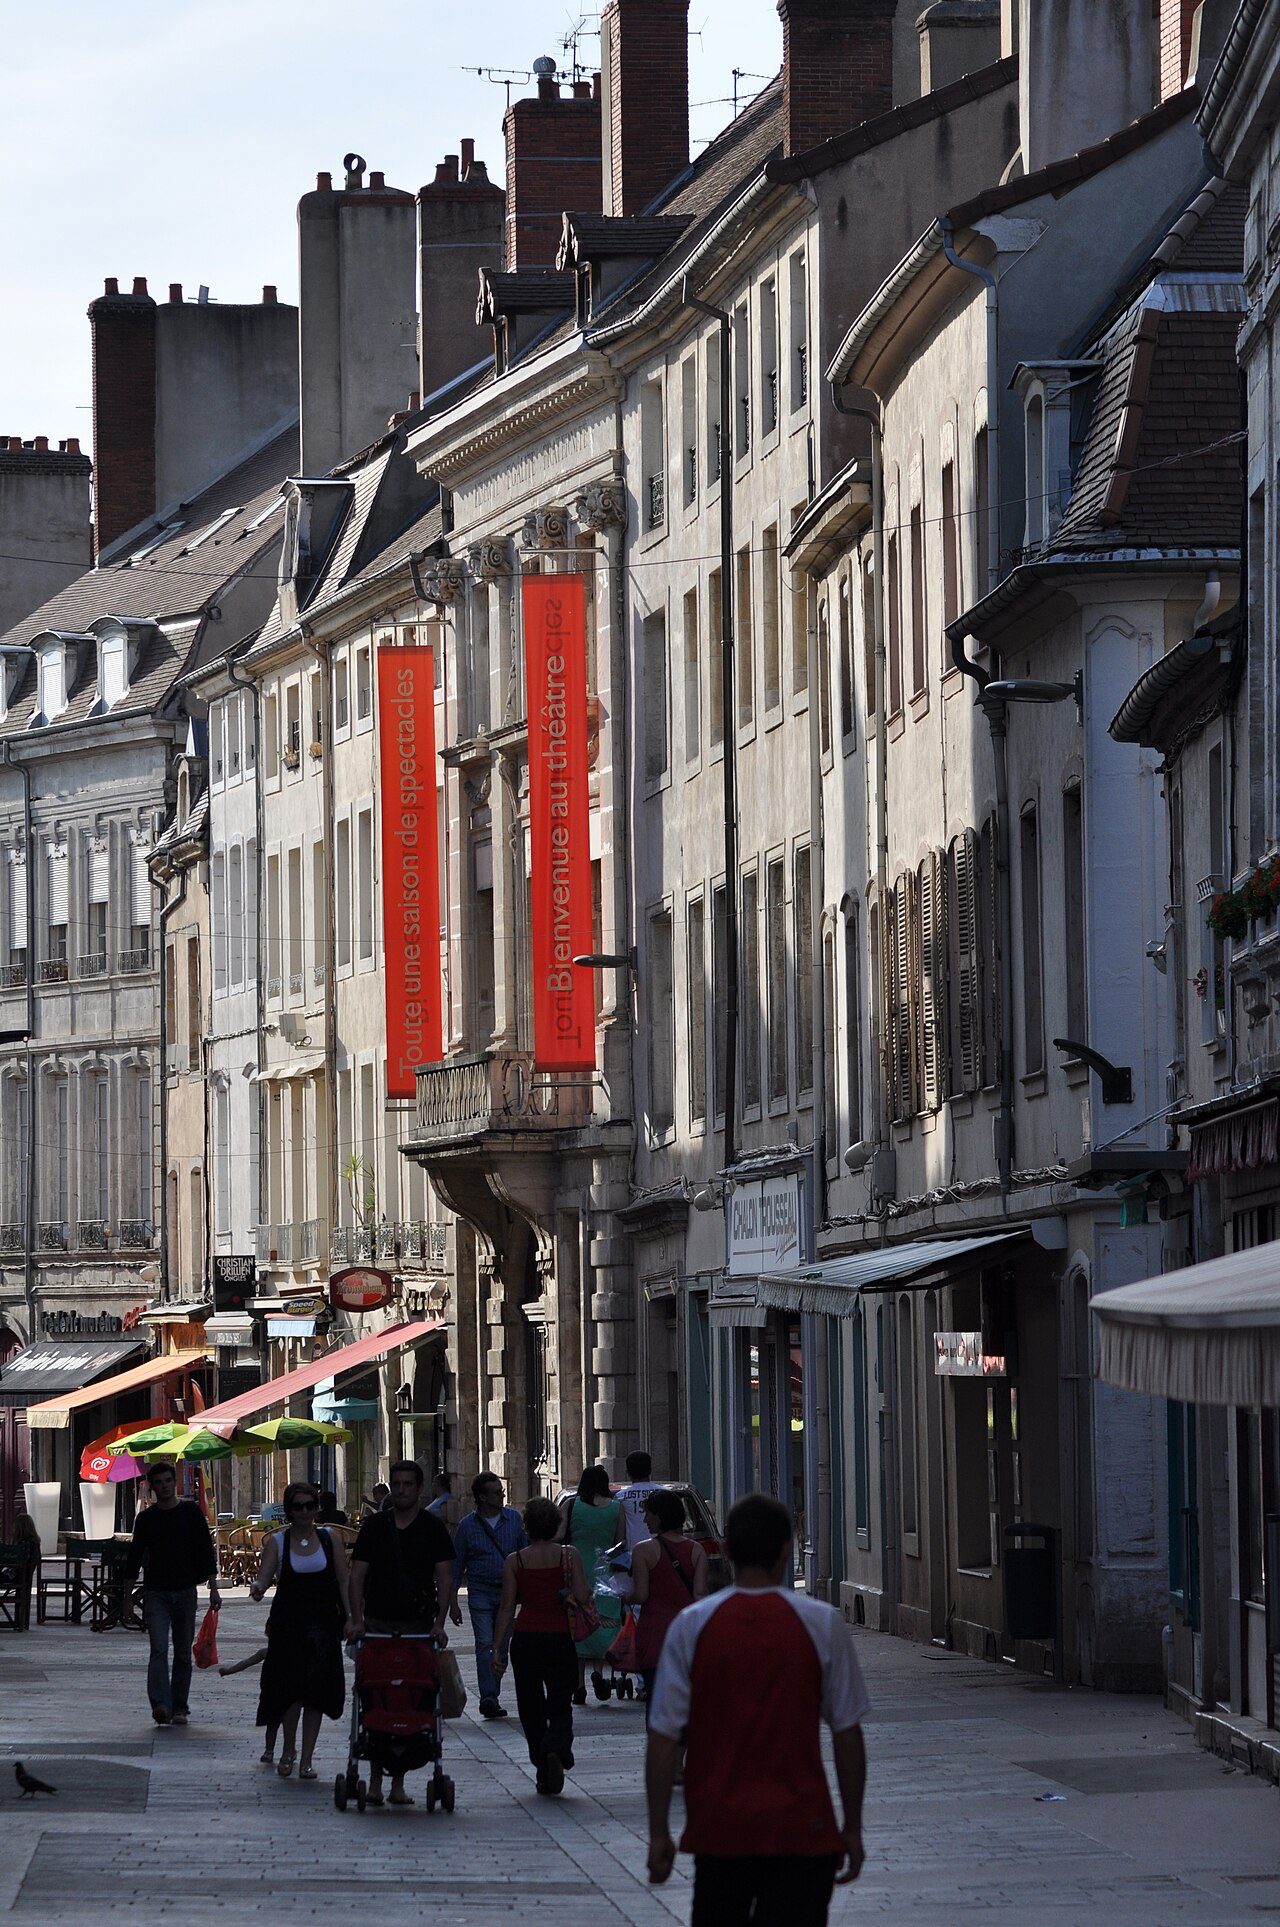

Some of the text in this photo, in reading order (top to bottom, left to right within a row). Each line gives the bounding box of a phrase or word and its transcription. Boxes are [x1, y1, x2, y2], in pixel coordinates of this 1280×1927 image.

[541, 655, 568, 770] théâtre
[550, 782, 569, 817] au
[390, 668, 424, 1078] Toute une saison de spectacles
[547, 827, 573, 992] Bienvenue
[216, 1257, 254, 1267] CHRISTIAN
[288, 1300, 315, 1308] Speed
[624, 1490, 641, 1500] LOST
